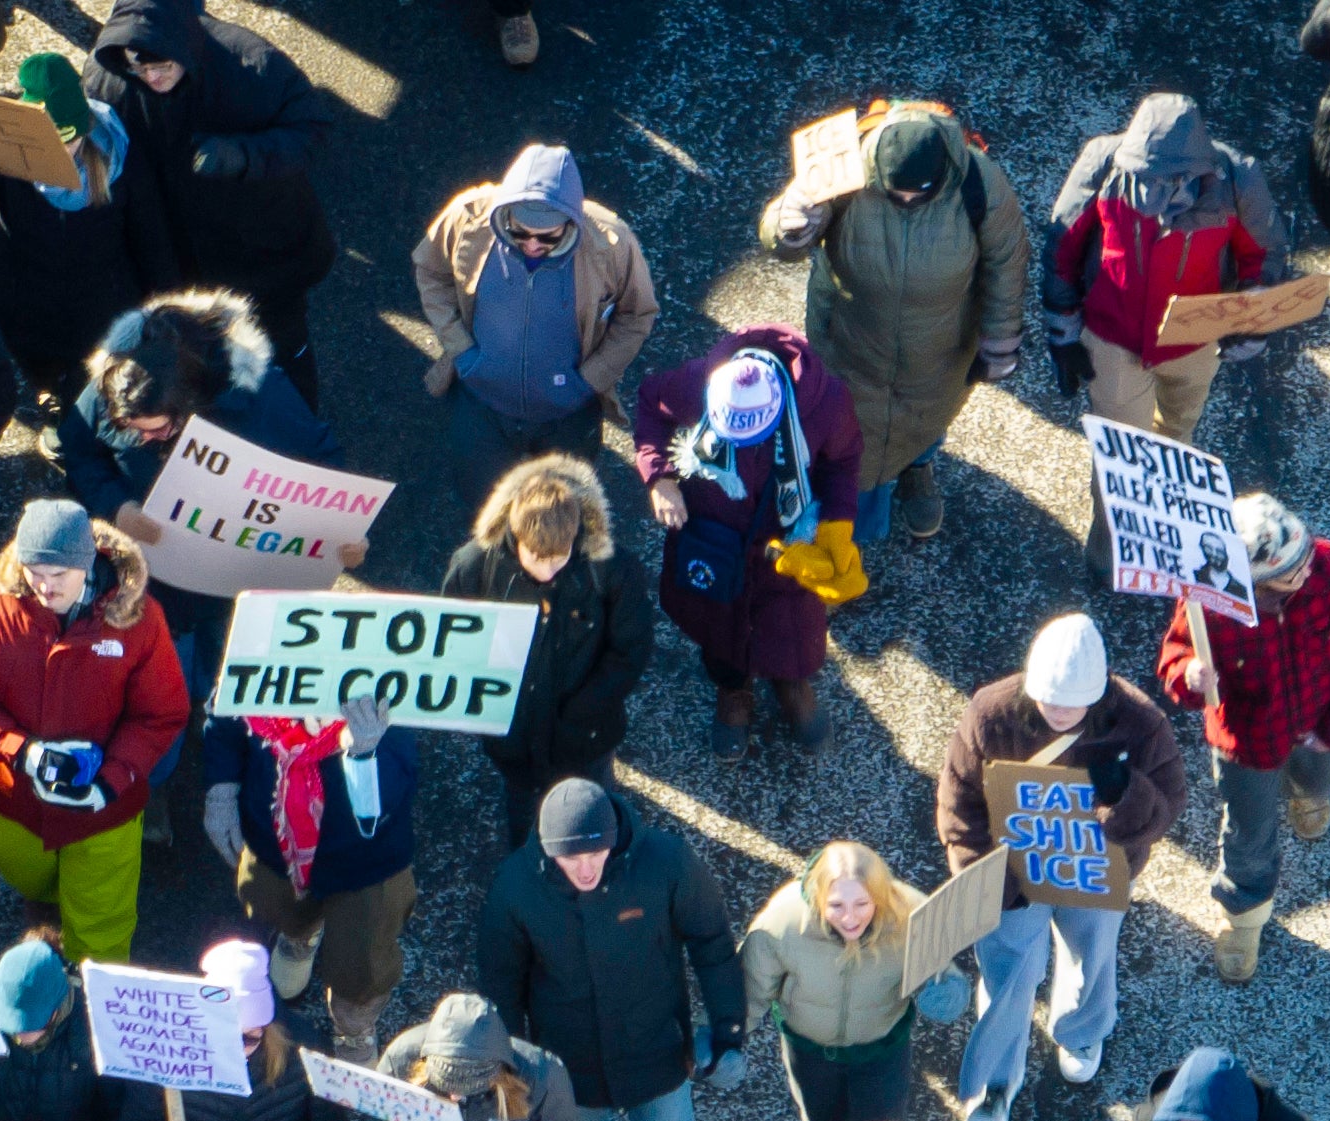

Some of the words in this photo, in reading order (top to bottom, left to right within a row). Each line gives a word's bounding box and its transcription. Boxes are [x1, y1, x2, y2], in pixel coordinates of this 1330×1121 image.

[182, 438, 231, 476] NO
[243, 468, 379, 516] HUMAN
[1097, 425, 1227, 498] JUSTICE
[242, 499, 280, 524] IS
[1106, 471, 1158, 511] ALEX
[1163, 490, 1237, 534] PRETTI
[170, 498, 325, 559] ILLEGAL
[1111, 508, 1183, 549] KILLED
[1119, 535, 1145, 567] BY
[1153, 547, 1187, 579] ICE
[281, 608, 484, 657] STOP
[227, 665, 324, 705] THE
[338, 668, 512, 716] COUP
[1016, 781, 1094, 813] EAT
[999, 814, 1107, 855] SHIT
[1026, 851, 1110, 895] ICE
[105, 1000, 208, 1031] BLONDE
[114, 986, 199, 1010] WHITE
[112, 1018, 207, 1045] WOMEN
[119, 1035, 216, 1062] AGAINST
